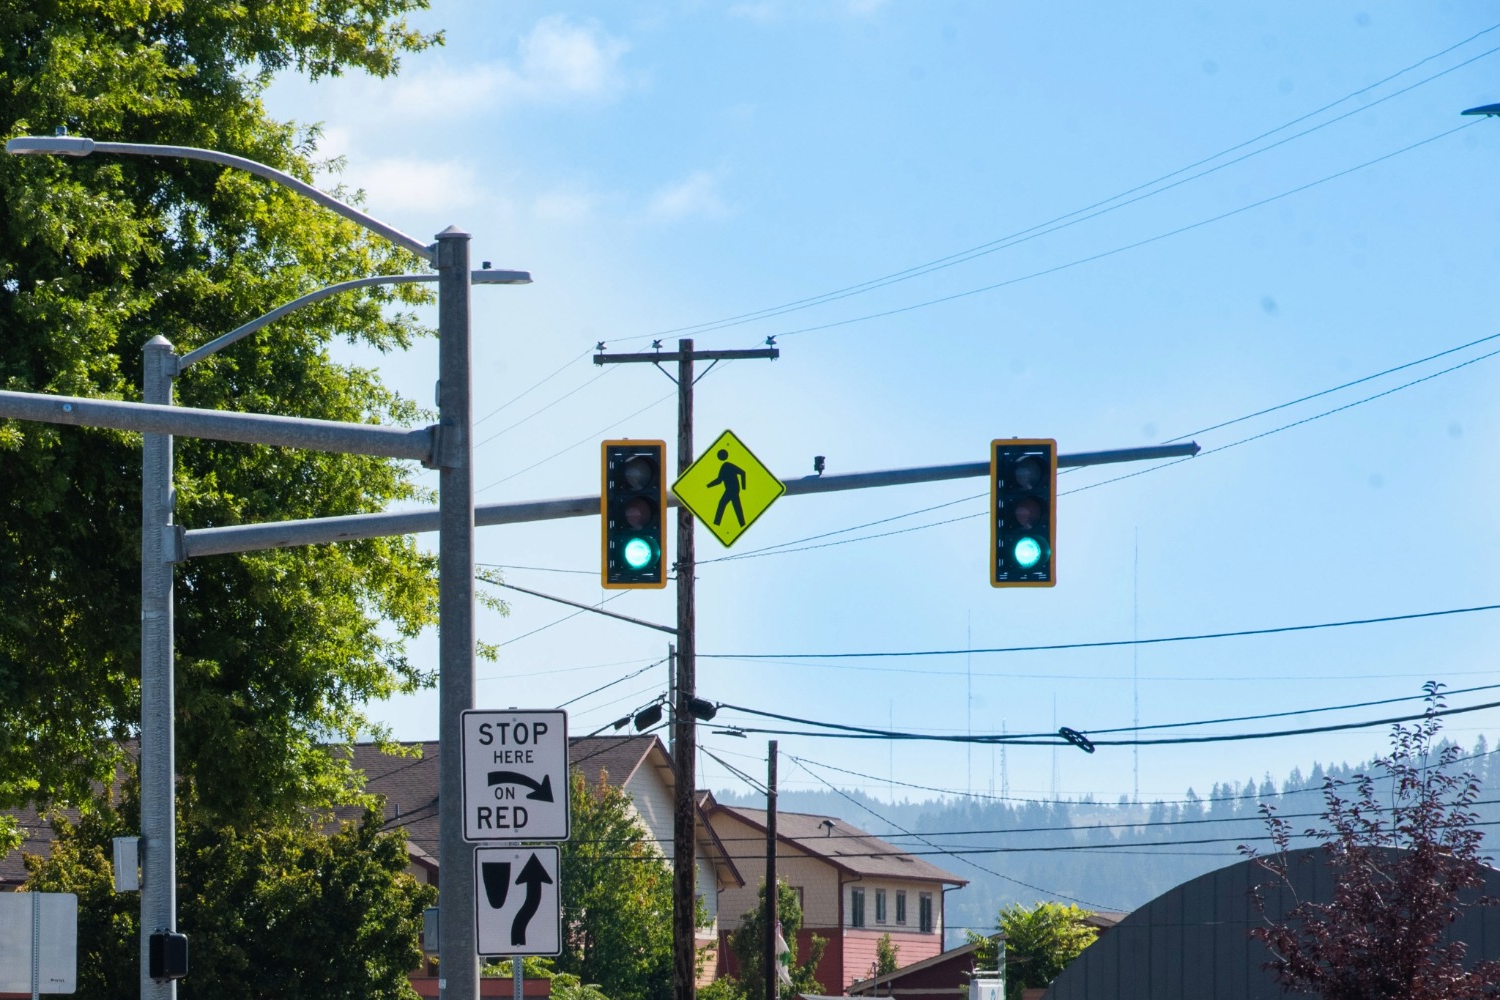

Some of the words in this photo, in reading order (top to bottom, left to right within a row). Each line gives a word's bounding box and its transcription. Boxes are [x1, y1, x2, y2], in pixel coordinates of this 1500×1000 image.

[478, 722, 549, 746] STOP
[493, 750, 534, 764] HERE
[494, 786, 515, 800] ON
[477, 806, 529, 830] RED
